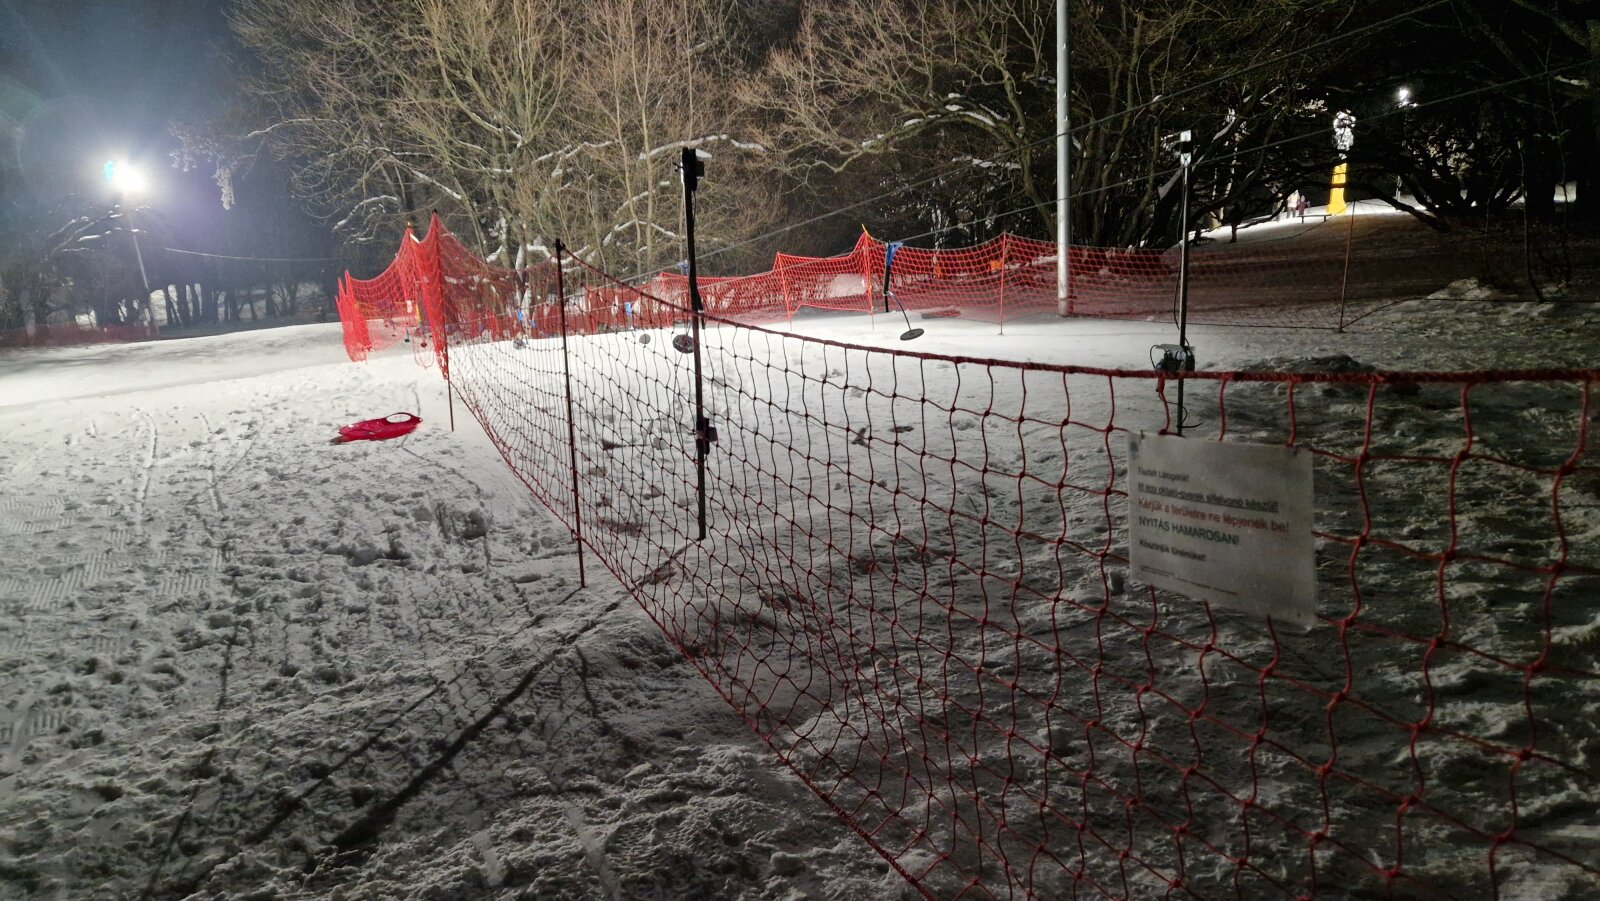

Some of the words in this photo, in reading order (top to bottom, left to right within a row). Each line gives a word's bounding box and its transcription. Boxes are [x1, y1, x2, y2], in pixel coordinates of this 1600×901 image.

[1138, 497, 1163, 513] Kérjük
[1164, 505, 1170, 513] a
[1209, 512, 1220, 523] ne
[1271, 520, 1290, 533] be!
[1139, 516, 1170, 532] NYITÁS
